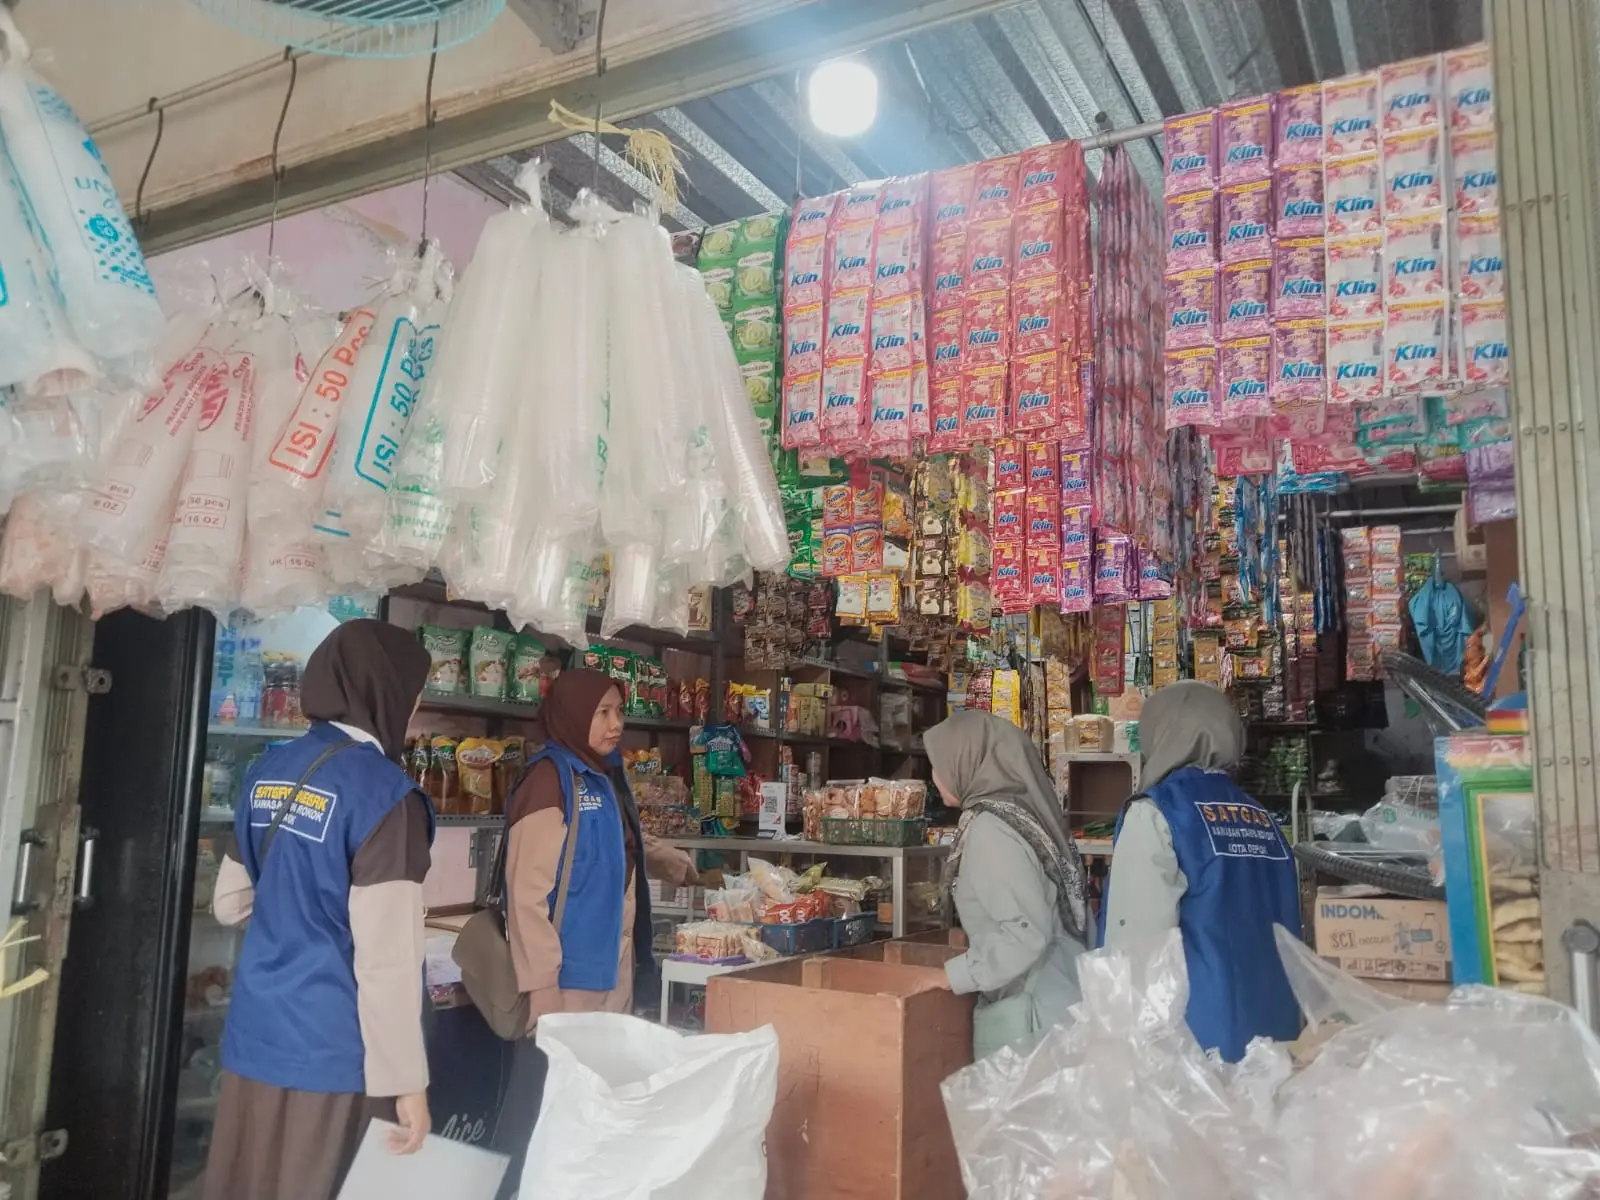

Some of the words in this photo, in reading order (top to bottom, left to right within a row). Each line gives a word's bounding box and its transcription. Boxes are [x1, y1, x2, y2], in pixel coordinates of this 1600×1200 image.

[1390, 92, 1430, 111] Klin
[1332, 118, 1372, 135] Klin
[1227, 145, 1264, 162] Klin
[1171, 155, 1206, 172] Klin
[1024, 171, 1056, 188] Klin
[1392, 173, 1433, 191] Klin
[980, 187, 1009, 201] Klin
[882, 198, 911, 213] Klin
[937, 205, 966, 221] Klin
[1284, 200, 1323, 217] Klin
[1335, 198, 1374, 214] Klin
[798, 211, 826, 223] Klin
[1228, 223, 1265, 241] Klin
[1172, 232, 1207, 249] Klin
[1021, 242, 1052, 258] Klin
[839, 256, 866, 270] Klin
[972, 256, 1004, 273] Klin
[1395, 257, 1436, 276] Klin
[791, 272, 818, 287] Klin
[876, 264, 906, 279] Klin
[1283, 279, 1323, 296] Klin
[1336, 280, 1377, 296] Klin
[1172, 310, 1208, 327] Klin
[1229, 302, 1267, 320] Klin
[831, 323, 860, 338] Klin
[1018, 316, 1050, 333] Klin
[875, 335, 905, 350] Klin
[968, 330, 1000, 346] Klin
[790, 340, 817, 357] Klin
[1395, 344, 1437, 362] Klin
[232, 356, 251, 379] Cup
[1281, 362, 1322, 379] Klin
[1337, 363, 1378, 380] Klin
[1229, 382, 1266, 398] Klin
[827, 394, 855, 409] Klin
[1018, 393, 1050, 410] Klin
[1172, 391, 1209, 406] Klin
[285, 421, 322, 460] ISI
[315, 370, 348, 402] 50
[789, 411, 814, 426] Klin
[873, 406, 905, 422] Klin
[966, 405, 996, 420] Klin
[373, 434, 399, 474] ISI
[390, 382, 413, 418] 50
[936, 416, 957, 432] Kli
[1000, 461, 1019, 473] Klin
[1032, 468, 1054, 478] Klin
[1066, 479, 1086, 489] Klin
[203, 515, 220, 525] OZ
[999, 514, 1018, 524] Klin
[1032, 520, 1053, 531] Klin
[1067, 532, 1086, 543] Klin
[997, 567, 1018, 577] Klin
[1033, 574, 1055, 585] Klin
[1100, 568, 1119, 578] Klin
[1065, 586, 1085, 598] Klin
[1203, 805, 1271, 828] SATGAS
